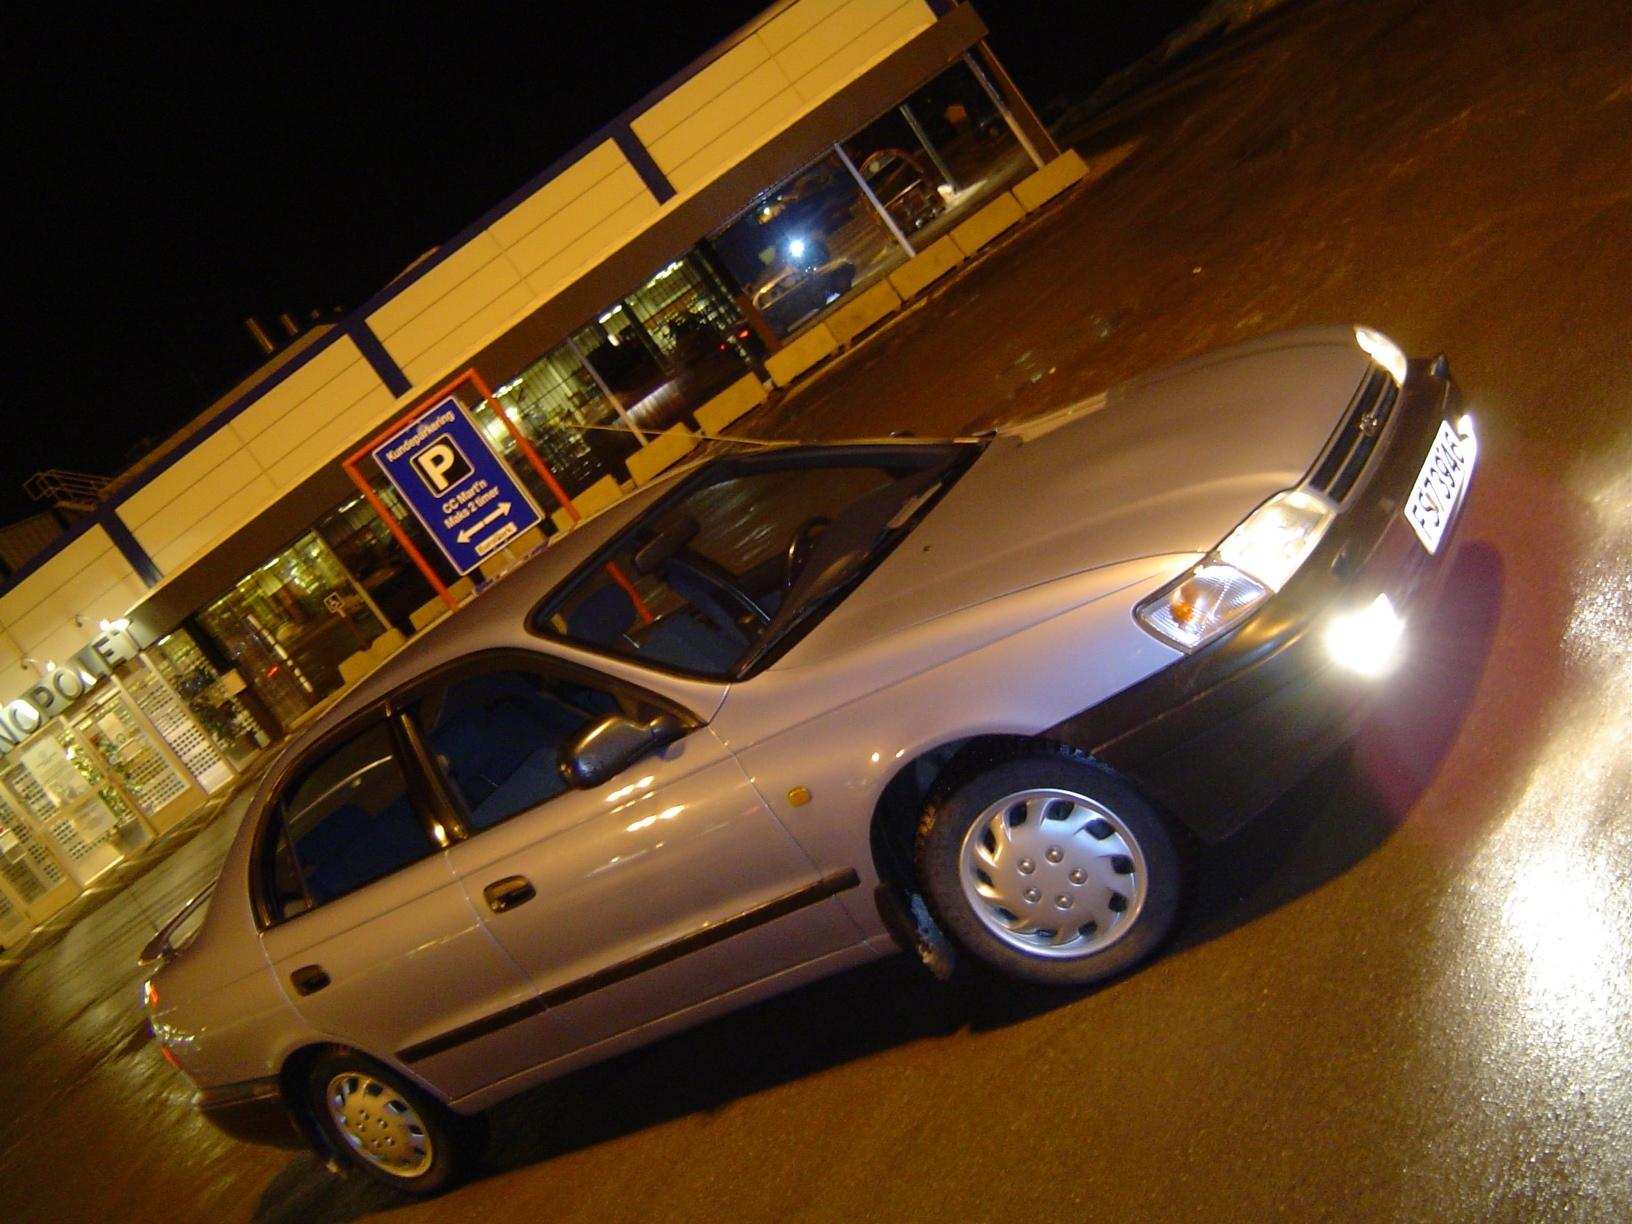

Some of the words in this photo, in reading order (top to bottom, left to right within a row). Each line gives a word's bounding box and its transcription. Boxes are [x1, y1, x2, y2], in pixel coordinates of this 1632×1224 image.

[386, 410, 456, 462] Kundeparkering
[417, 443, 455, 491] P
[442, 498, 459, 514] CC
[444, 507, 470, 529] Maks
[467, 501, 478, 513] 2
[474, 485, 499, 507] timer
